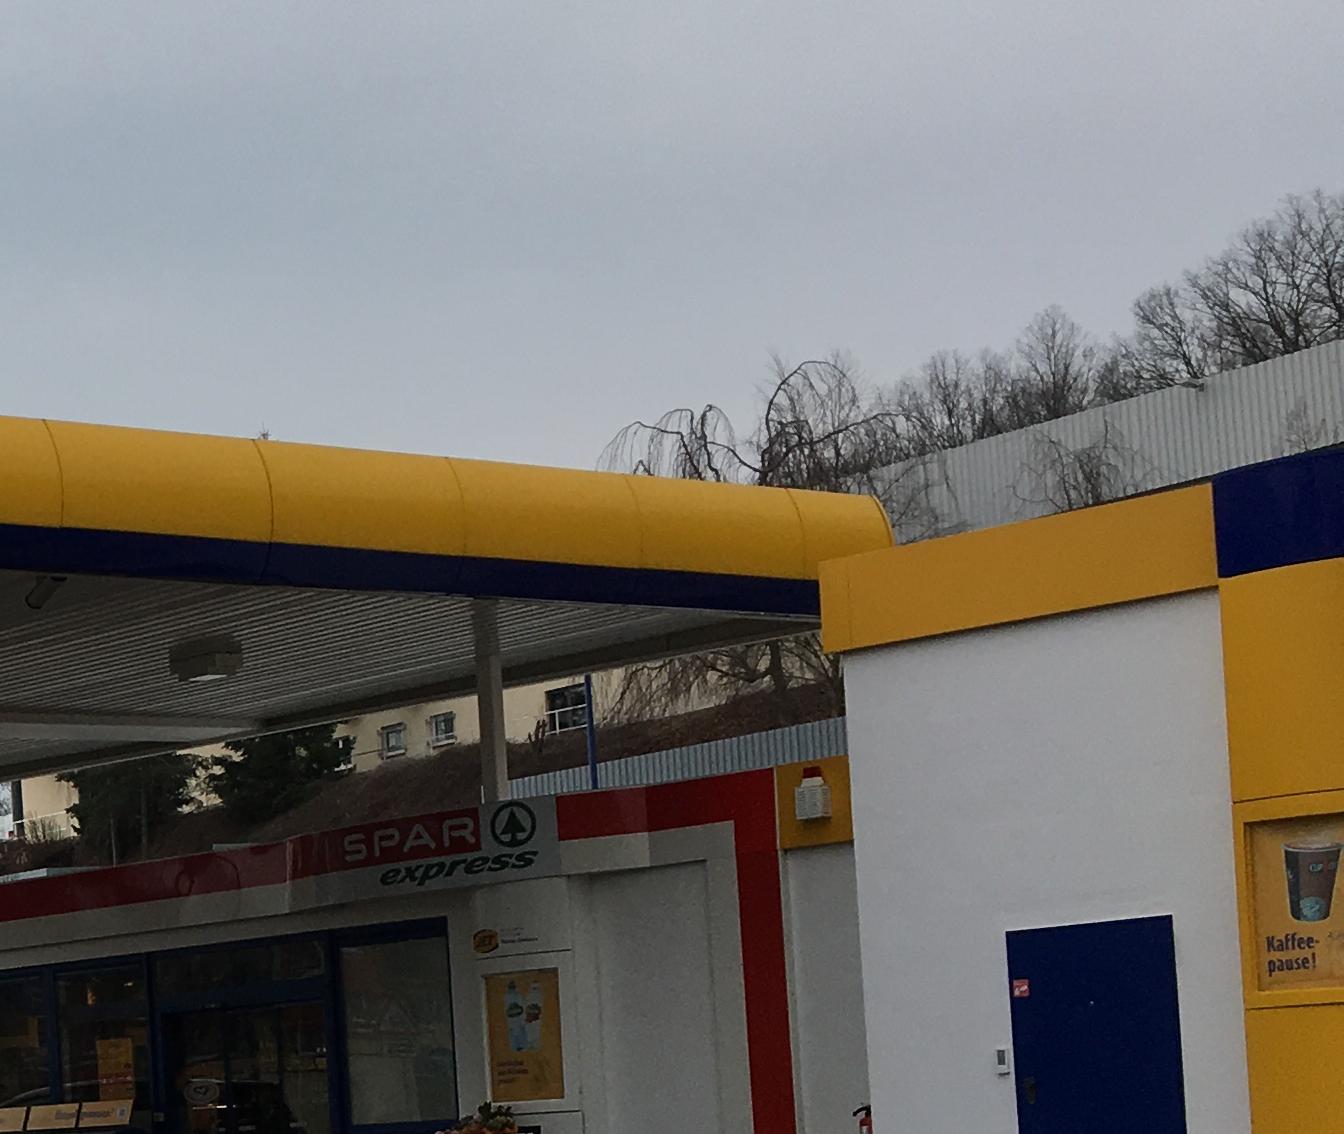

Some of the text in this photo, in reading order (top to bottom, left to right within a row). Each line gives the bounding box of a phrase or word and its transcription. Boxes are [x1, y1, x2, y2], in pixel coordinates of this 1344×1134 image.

[343, 817, 476, 863] SPAR
[379, 850, 539, 887] express
[1265, 932, 1320, 953] Kaffee-
[1267, 952, 1317, 977] pause!
